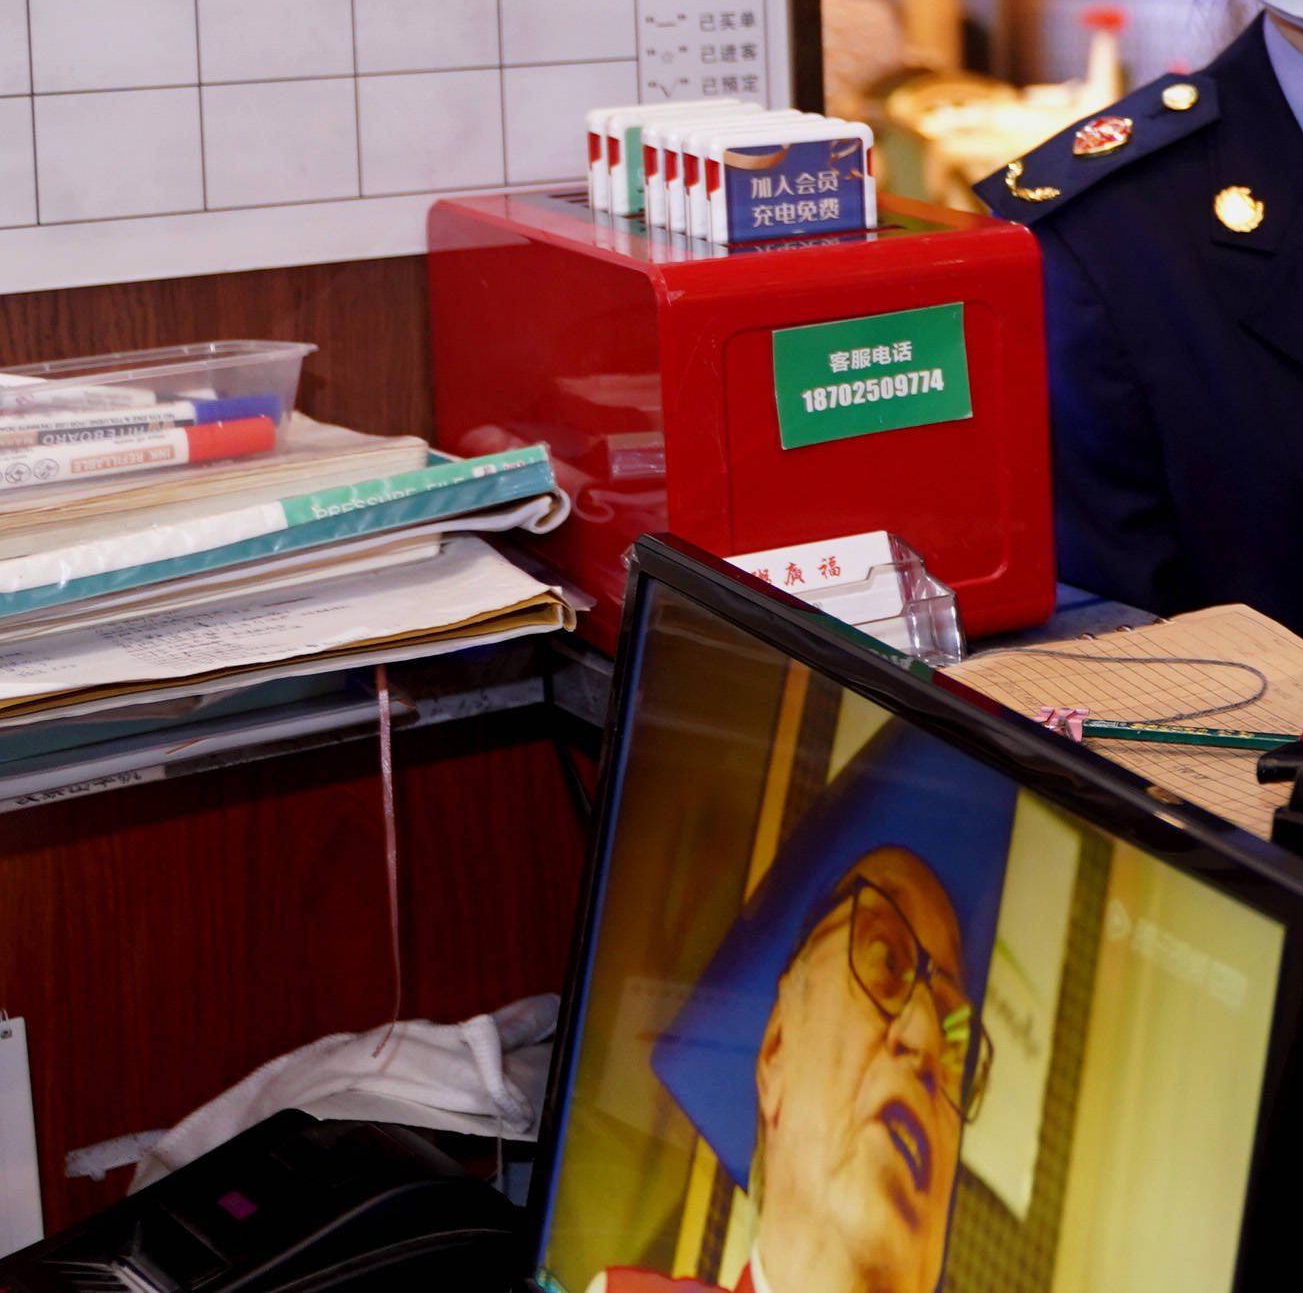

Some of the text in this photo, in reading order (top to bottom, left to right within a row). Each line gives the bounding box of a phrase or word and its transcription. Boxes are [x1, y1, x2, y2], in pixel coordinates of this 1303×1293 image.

[750, 171, 839, 200] 加入会员
[752, 198, 841, 228] 充电免费
[828, 341, 913, 373] 客服电话
[801, 368, 945, 413] 18702509774
[71, 450, 145, 474] REFILLABLE
